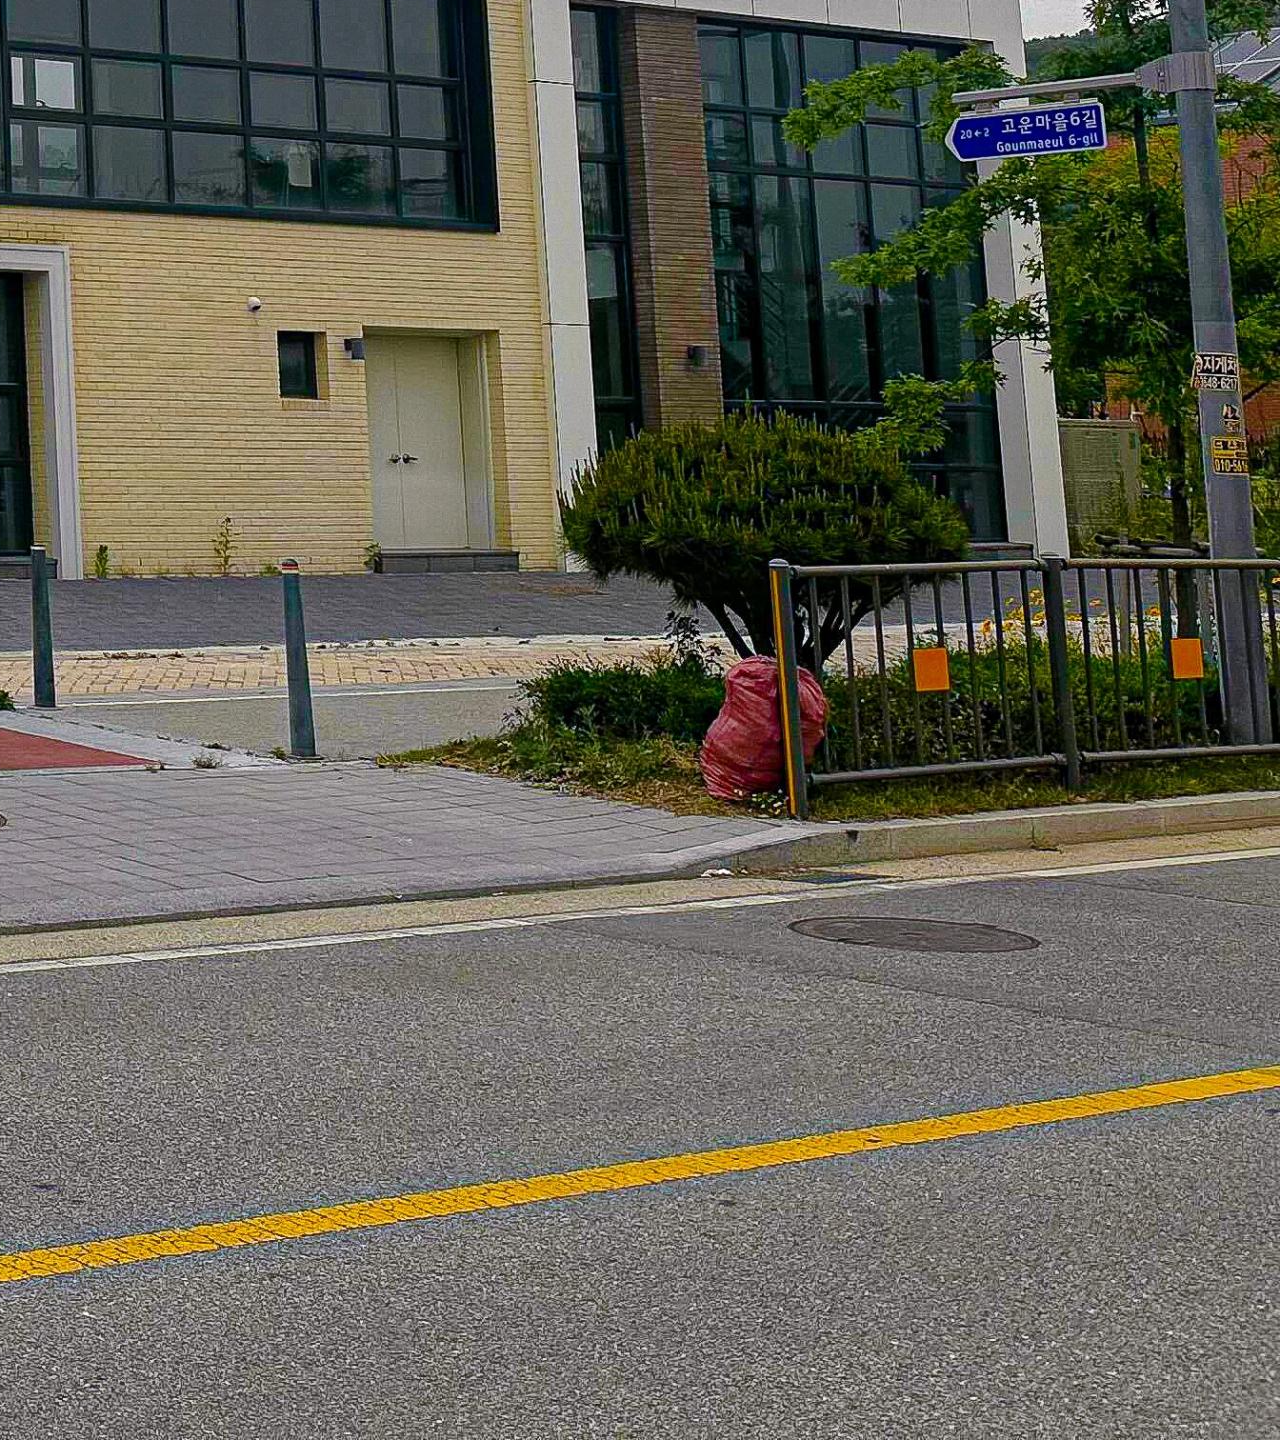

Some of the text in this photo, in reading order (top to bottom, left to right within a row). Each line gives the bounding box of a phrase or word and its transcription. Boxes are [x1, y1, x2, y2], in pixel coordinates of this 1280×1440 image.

[1001, 109, 1098, 135] 고운마을6길
[996, 132, 1100, 153] Gounmaeul 6-gil
